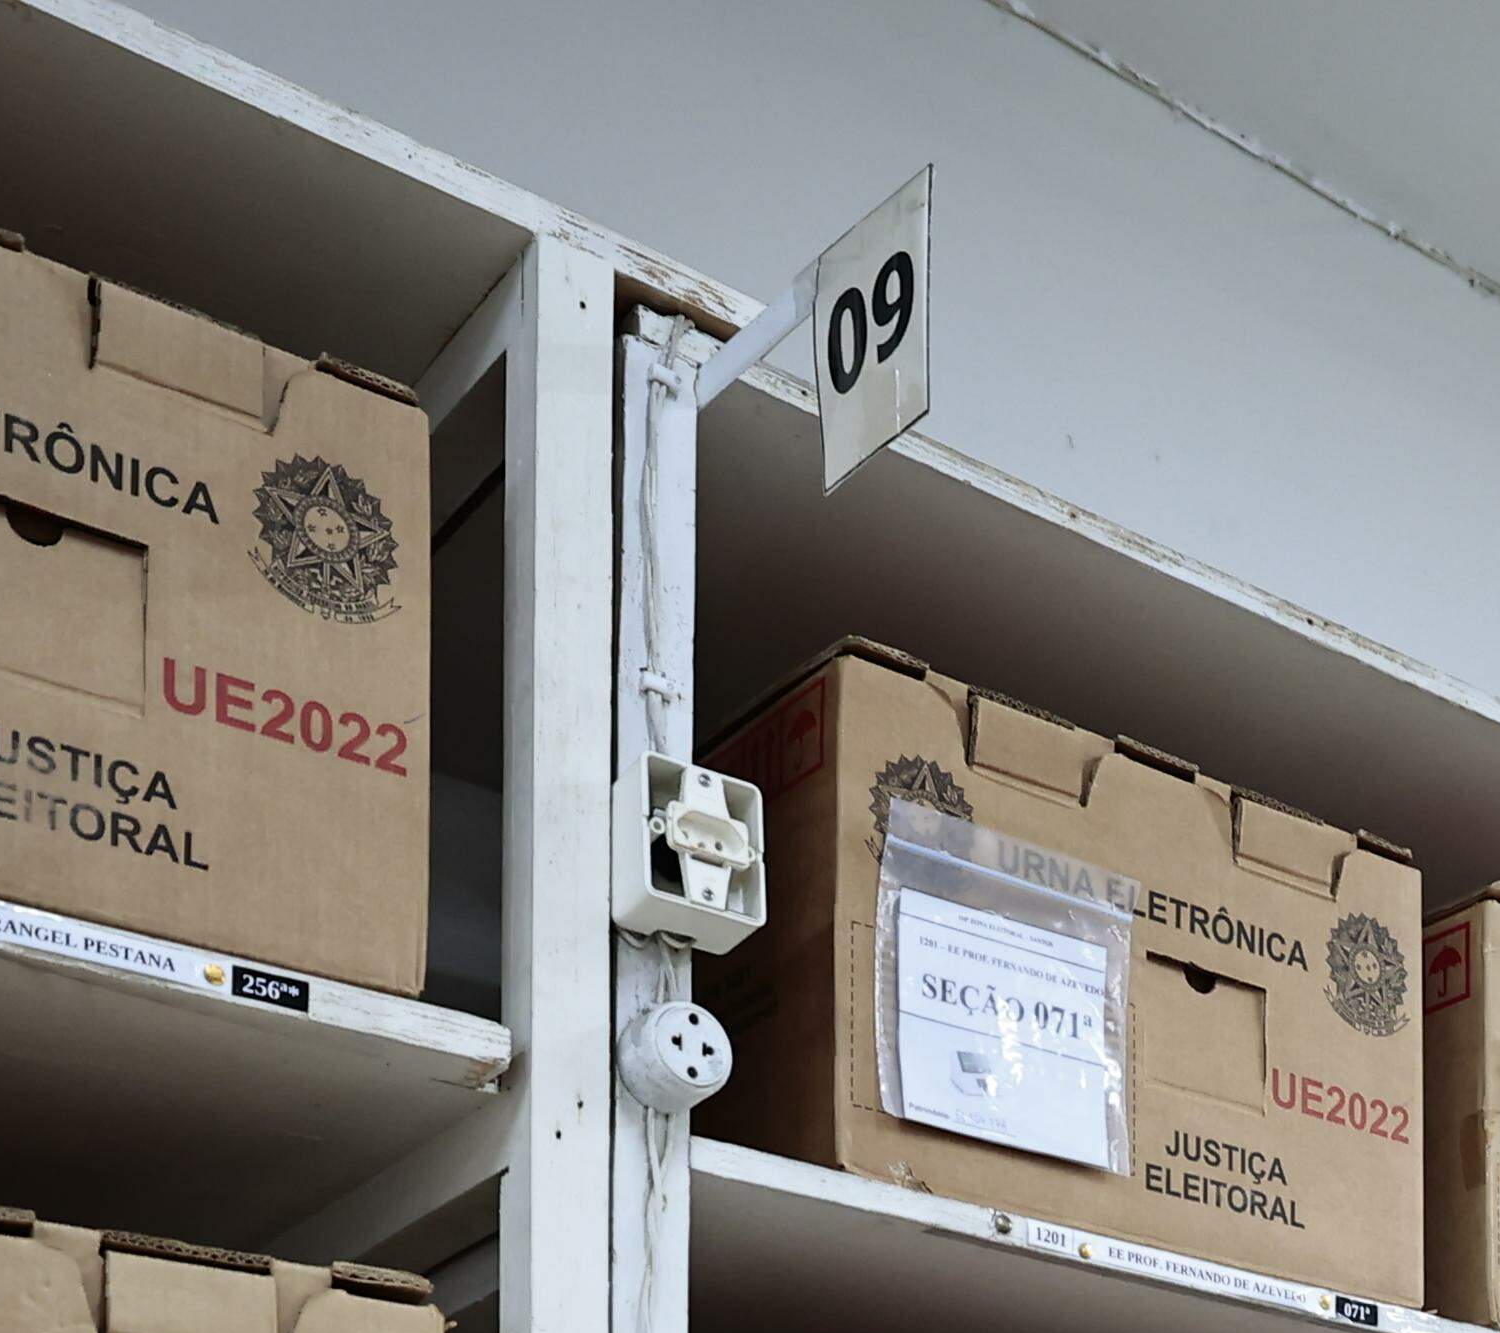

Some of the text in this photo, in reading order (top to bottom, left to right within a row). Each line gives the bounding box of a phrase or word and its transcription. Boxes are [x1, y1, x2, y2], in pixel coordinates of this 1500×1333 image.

[827, 250, 915, 395] 09
[161, 656, 409, 776] UE2022
[82, 934, 177, 973] PESTANA
[998, 840, 1095, 900] URNA
[1105, 878, 1308, 972] ELETRÔNICA
[921, 972, 1094, 1041] SEÇÃO 071ª
[1271, 1068, 1410, 1144] UE2022
